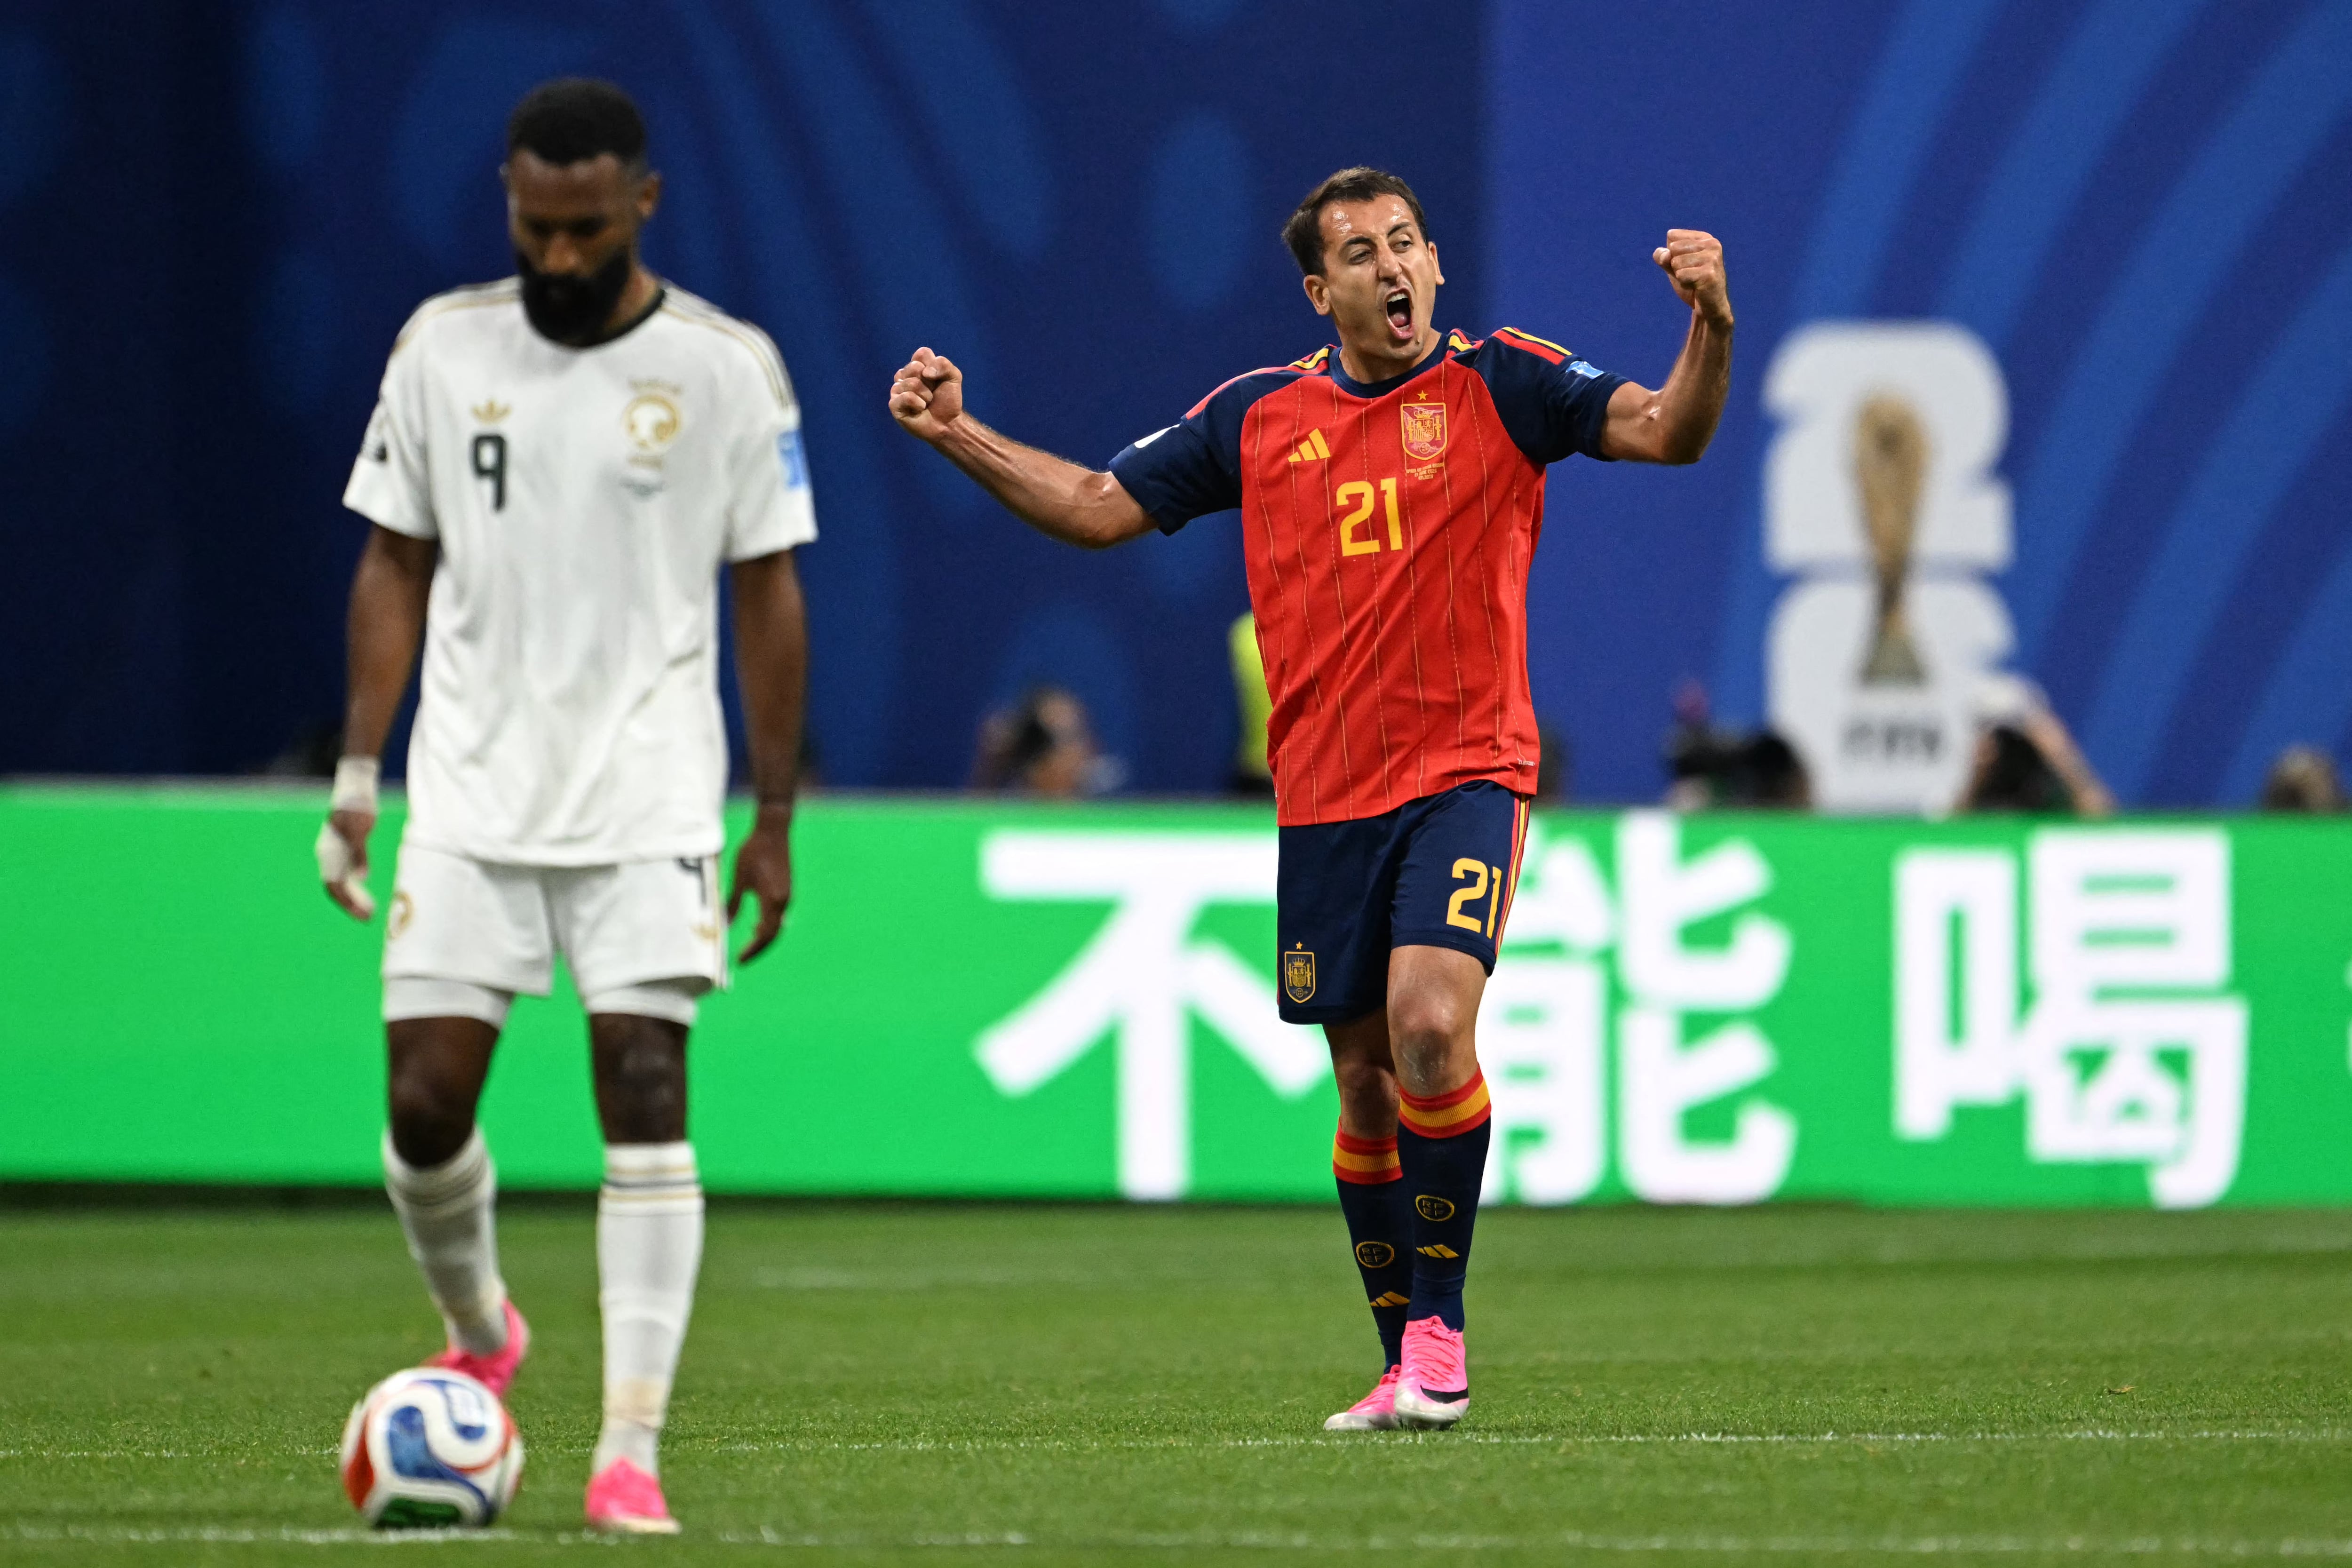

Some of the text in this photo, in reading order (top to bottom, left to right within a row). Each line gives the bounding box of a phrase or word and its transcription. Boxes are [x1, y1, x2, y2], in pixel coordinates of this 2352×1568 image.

[471, 433, 506, 512] 9
[1336, 477, 1403, 557] 21
[1446, 858, 1502, 939] 21
[973, 812, 2352, 1207] 不能喝
